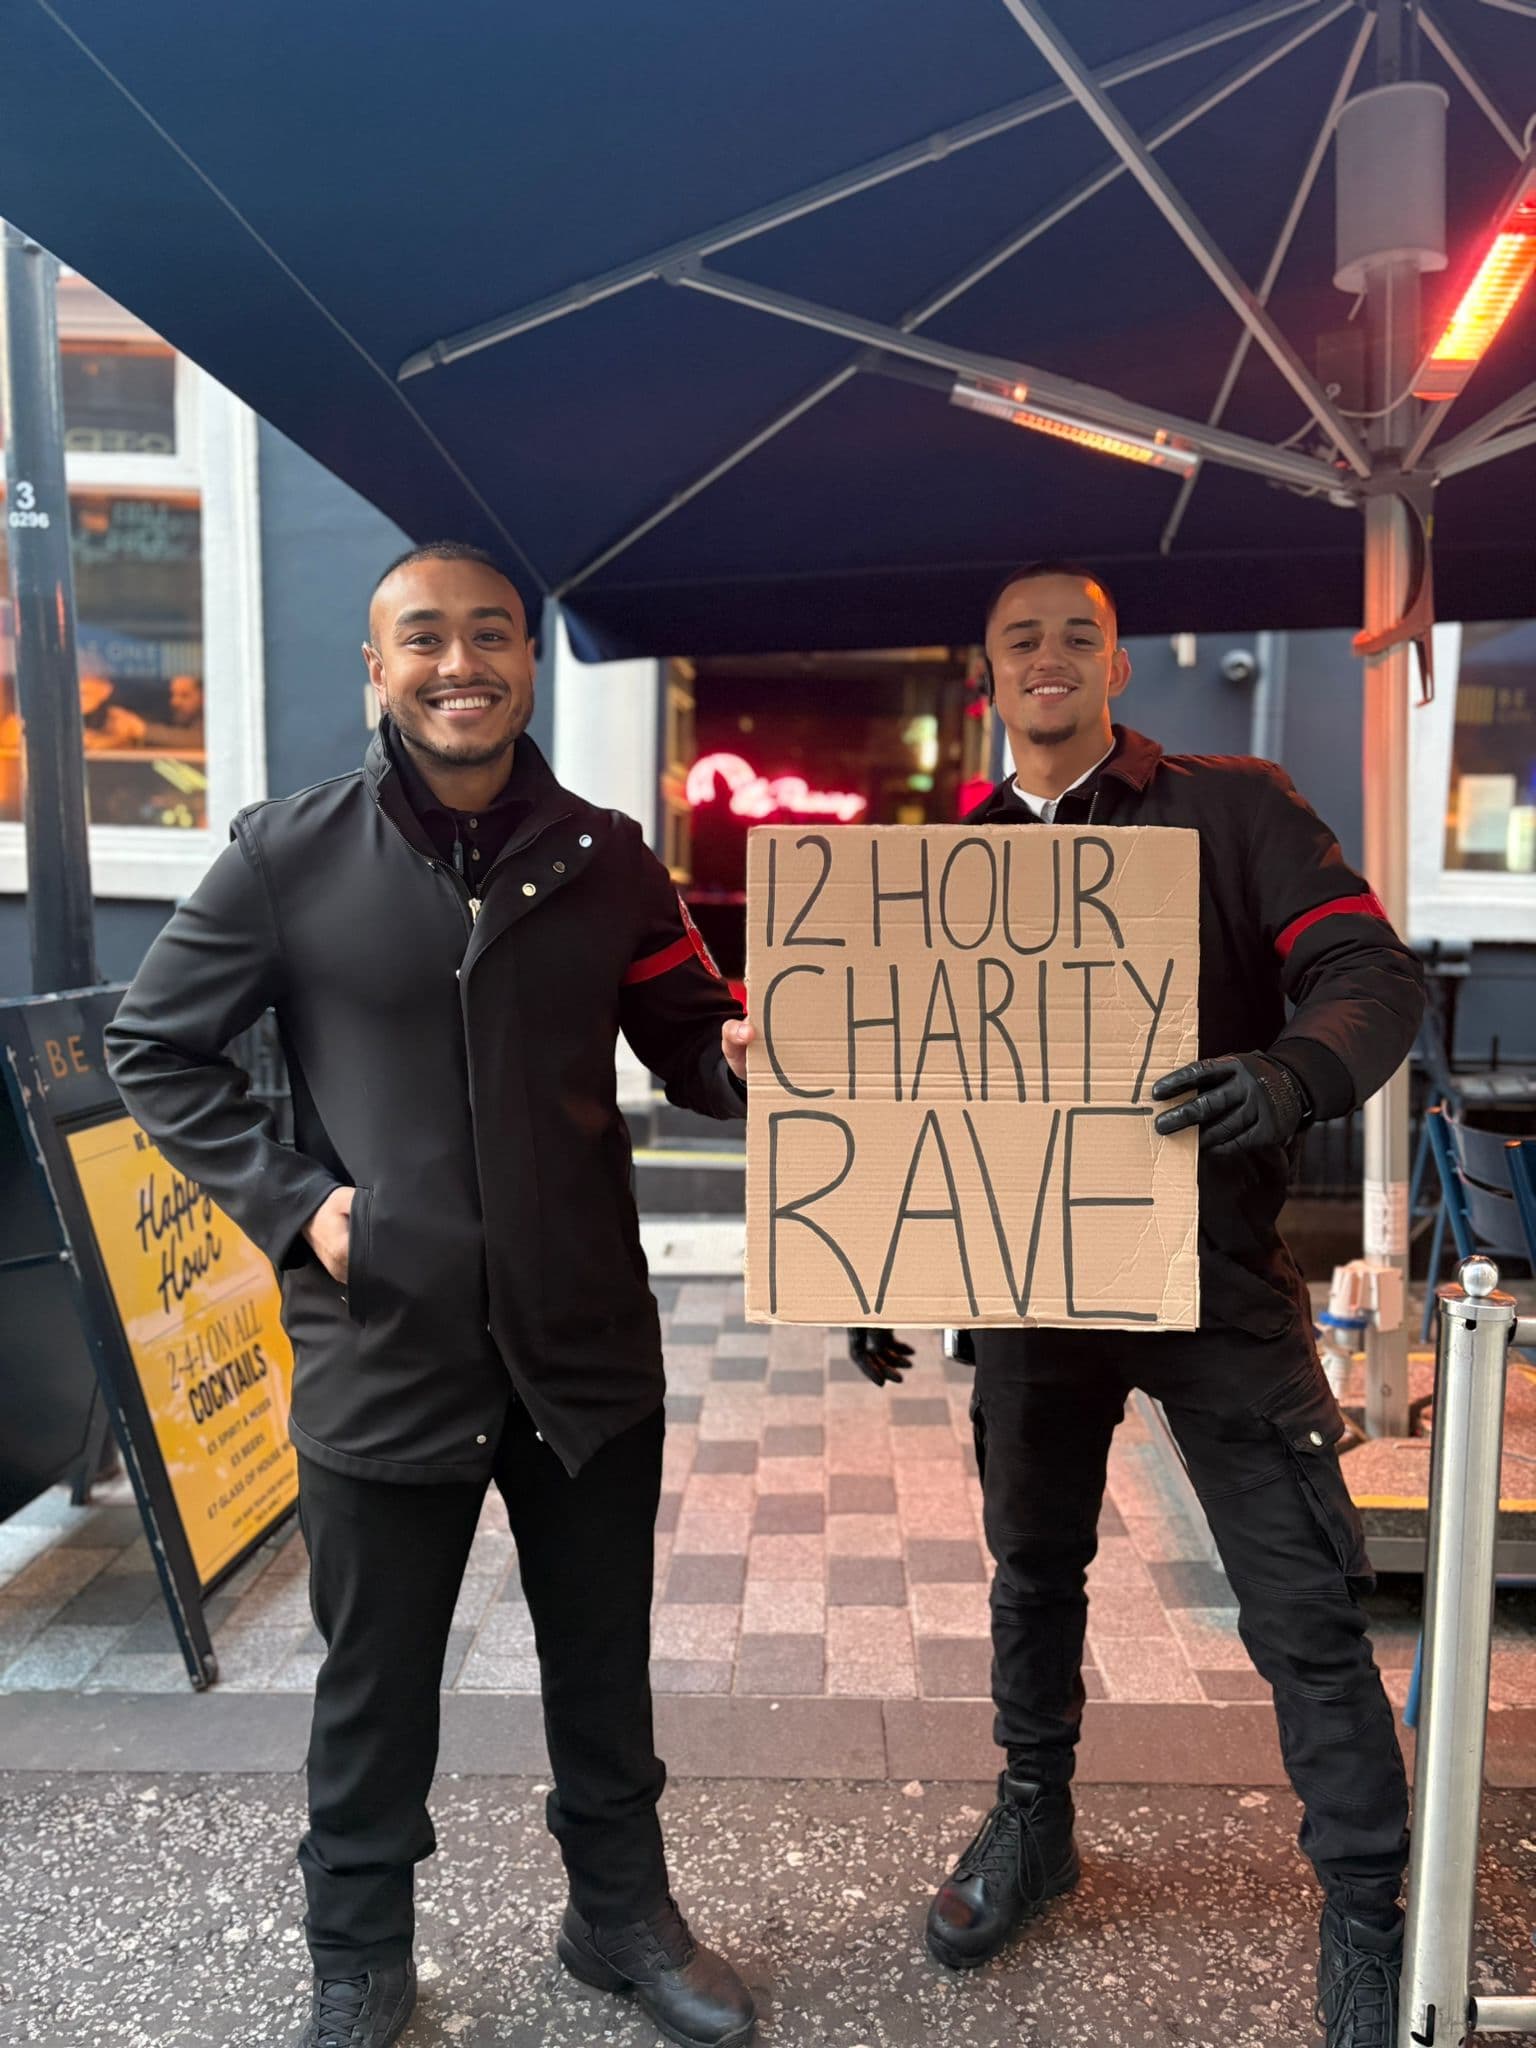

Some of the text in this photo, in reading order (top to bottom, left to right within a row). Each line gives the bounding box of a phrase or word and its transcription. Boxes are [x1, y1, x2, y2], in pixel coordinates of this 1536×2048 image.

[9, 511, 50, 529] 0296
[15, 481, 35, 510] 3
[766, 834, 1126, 956] 12 HOUR
[44, 1035, 91, 1079] BE
[763, 957, 1176, 1104] CHARITY
[768, 1107, 1159, 1323] RAVE
[157, 1233, 222, 1315] Hour
[234, 1298, 262, 1348] ALL
[188, 1342, 268, 1426] COCKTAILS
